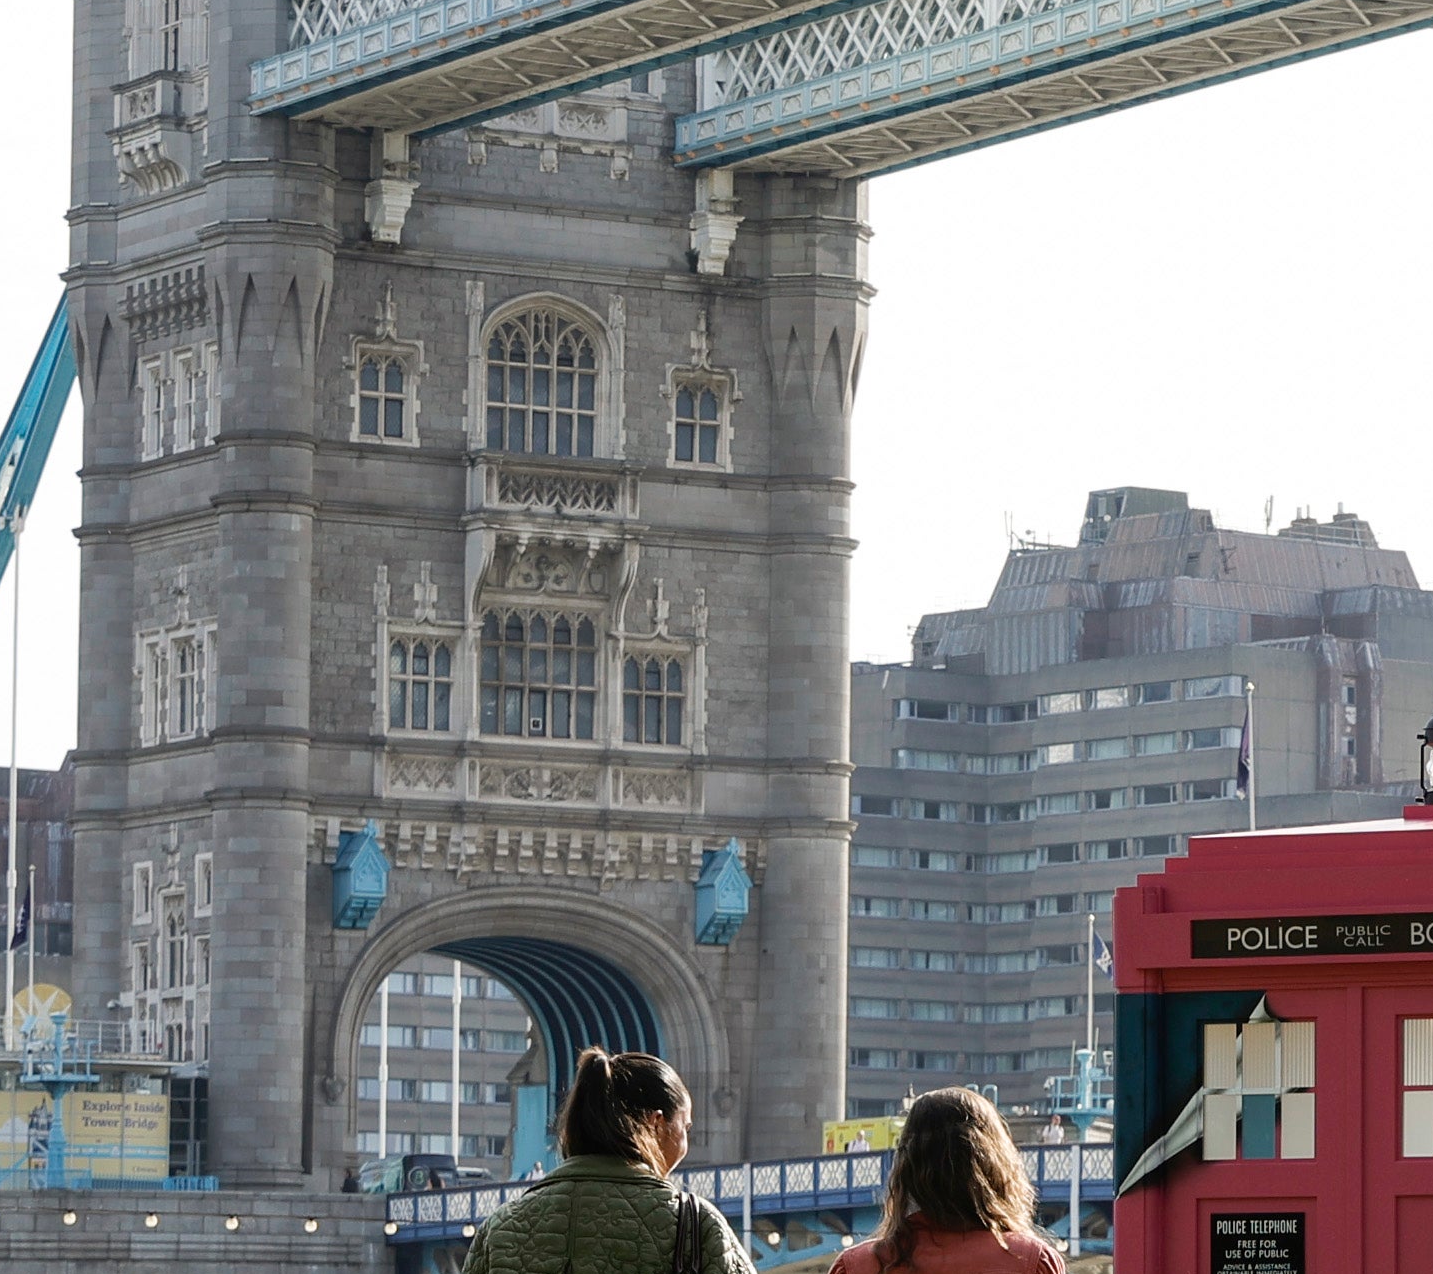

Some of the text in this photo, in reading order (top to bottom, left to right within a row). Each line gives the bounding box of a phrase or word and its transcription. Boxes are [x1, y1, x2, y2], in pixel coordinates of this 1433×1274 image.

[1336, 925, 1391, 937] PUBLIC
[1227, 926, 1318, 951] POLICE
[1343, 936, 1384, 947] CALL
[83, 1100, 165, 1113] Explore Inside
[82, 1116, 158, 1130] Tower Bridge
[1216, 1219, 1297, 1235] POLICE TELEPHONE
[1237, 1240, 1277, 1248] FREE FOR
[1225, 1249, 1289, 1258] USE OF PUBLIC
